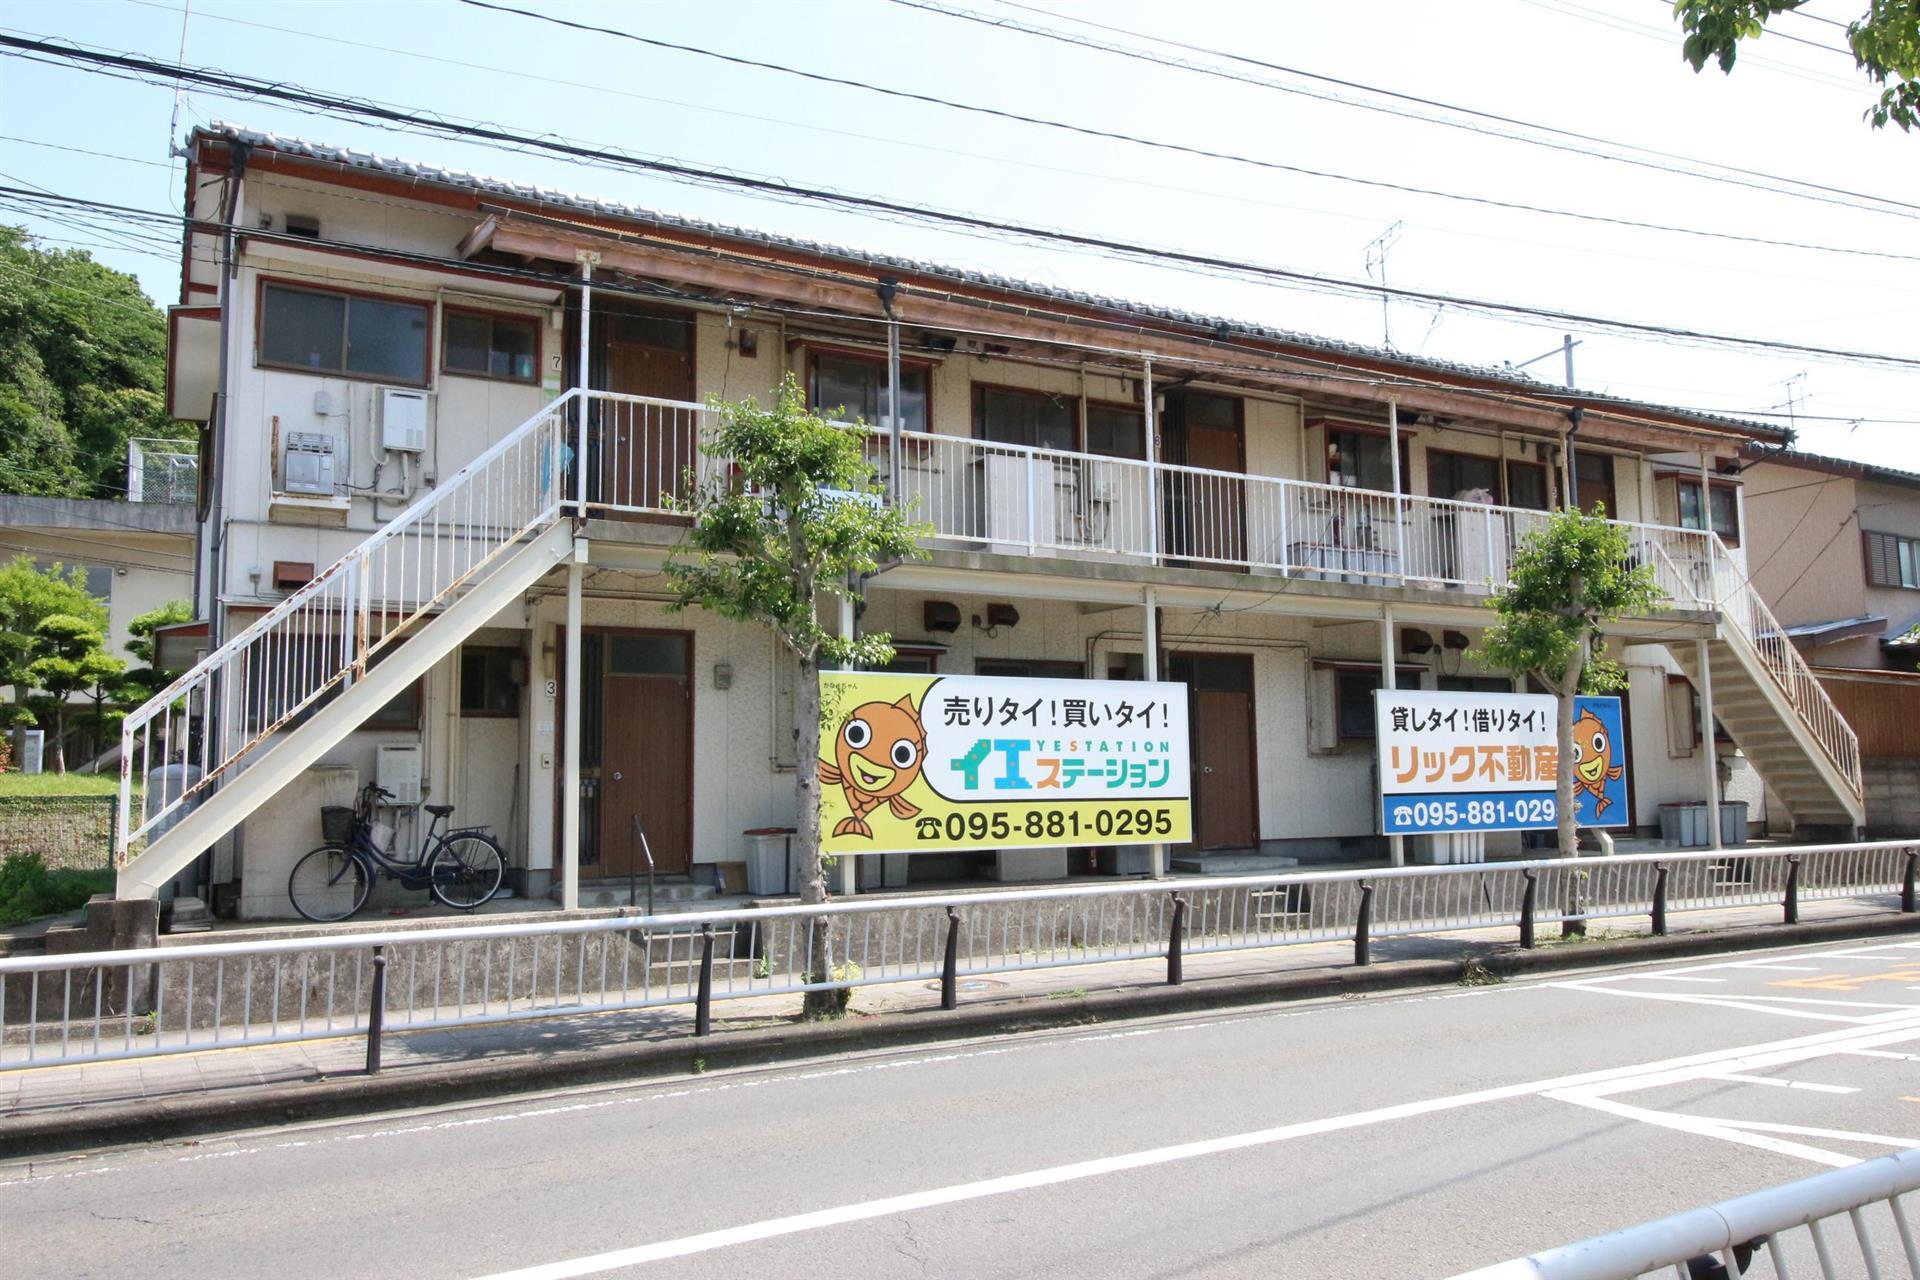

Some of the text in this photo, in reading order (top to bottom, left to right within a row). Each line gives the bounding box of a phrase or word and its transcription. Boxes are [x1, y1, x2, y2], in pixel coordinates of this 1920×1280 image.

[553, 355, 561, 369] 7
[547, 681, 555, 695] 3
[943, 696, 1168, 728] 売りタイ！買いタイ！
[1390, 706, 1546, 732] 貸しタイ！借りタイ！
[1036, 740, 1169, 752] YESTATION
[1391, 745, 1558, 784] リック不動産
[945, 809, 1172, 841] 095-881-0295
[1413, 799, 1558, 827] 095-881-029
